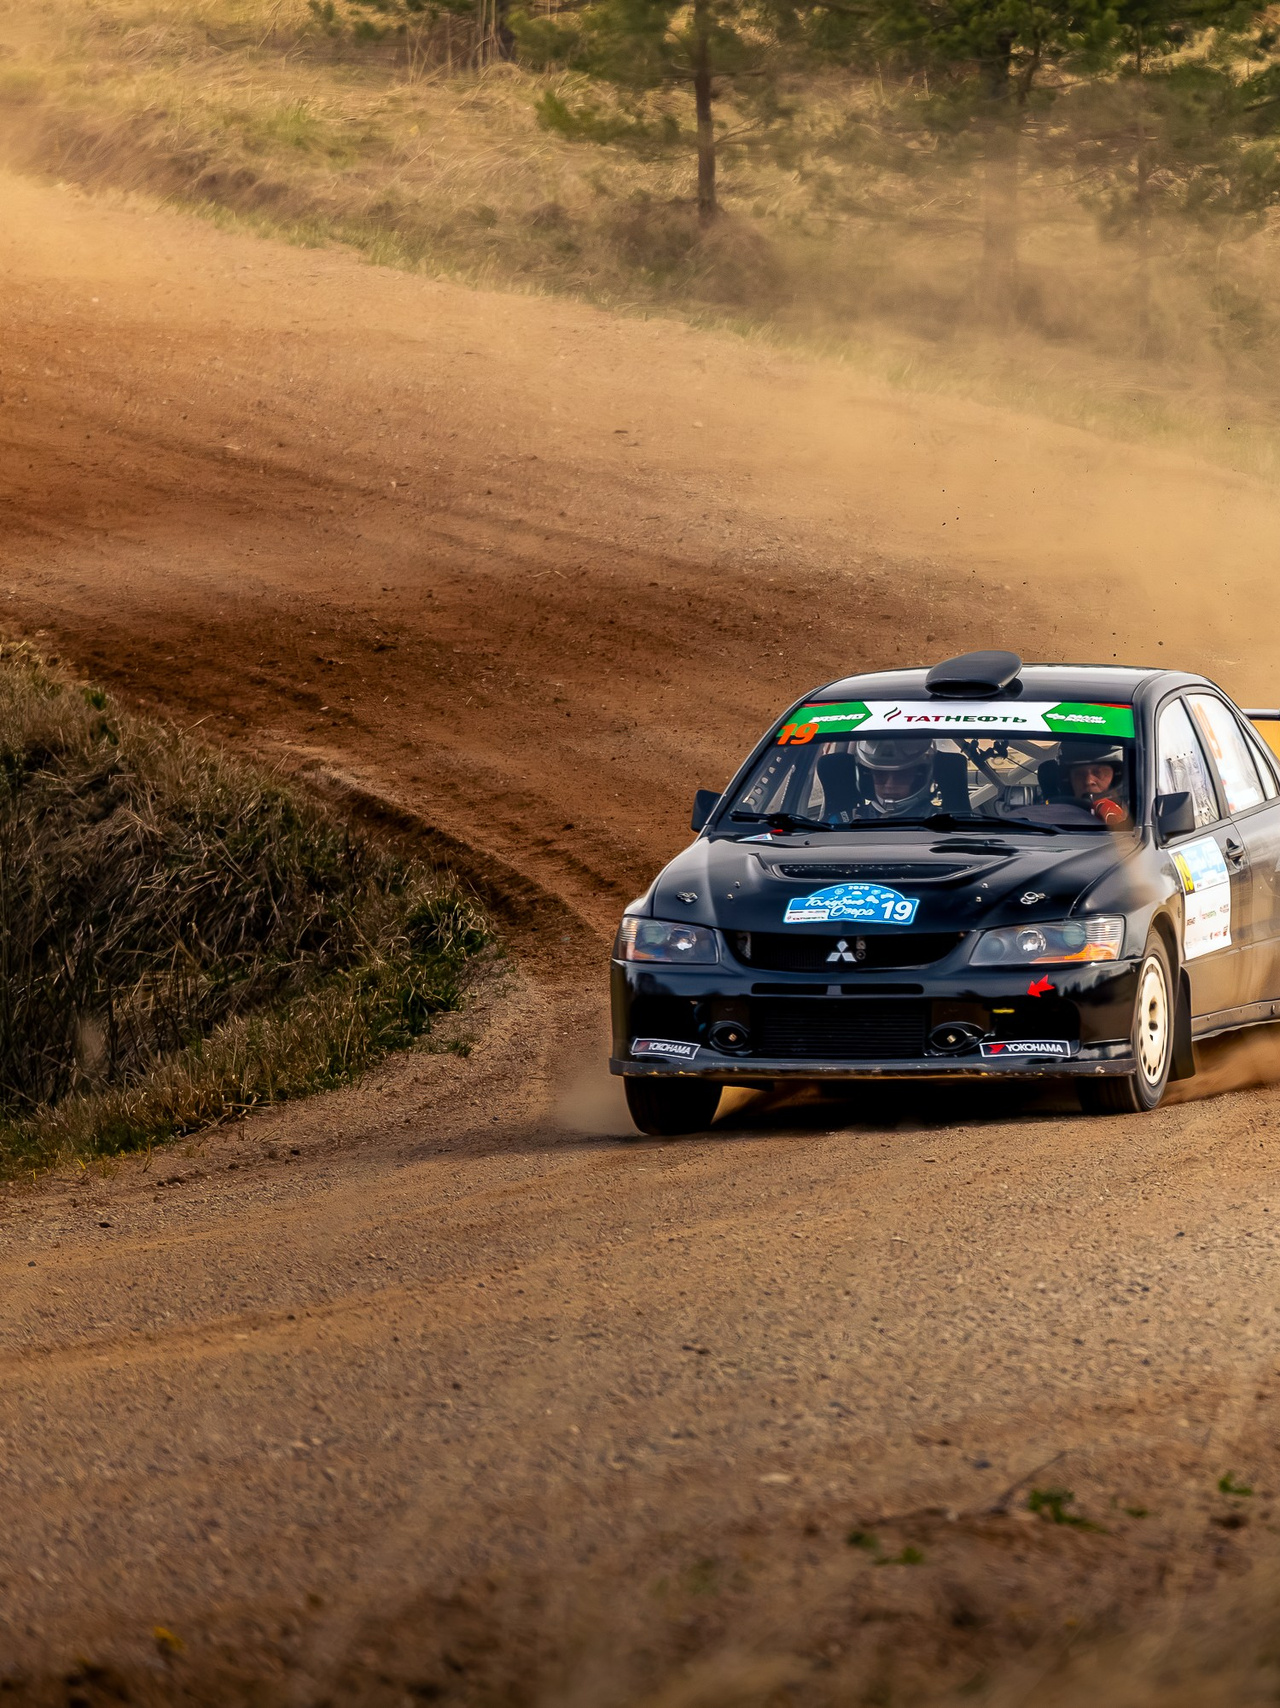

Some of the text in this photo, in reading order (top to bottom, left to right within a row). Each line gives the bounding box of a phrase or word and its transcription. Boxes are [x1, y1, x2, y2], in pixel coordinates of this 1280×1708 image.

[904, 715, 1027, 723] ТАТНЕФТЬ
[777, 722, 819, 745] 19
[881, 901, 913, 921] 19
[648, 1042, 691, 1055] YOKOHAMA
[1005, 1043, 1064, 1053] YOKOHAMA
